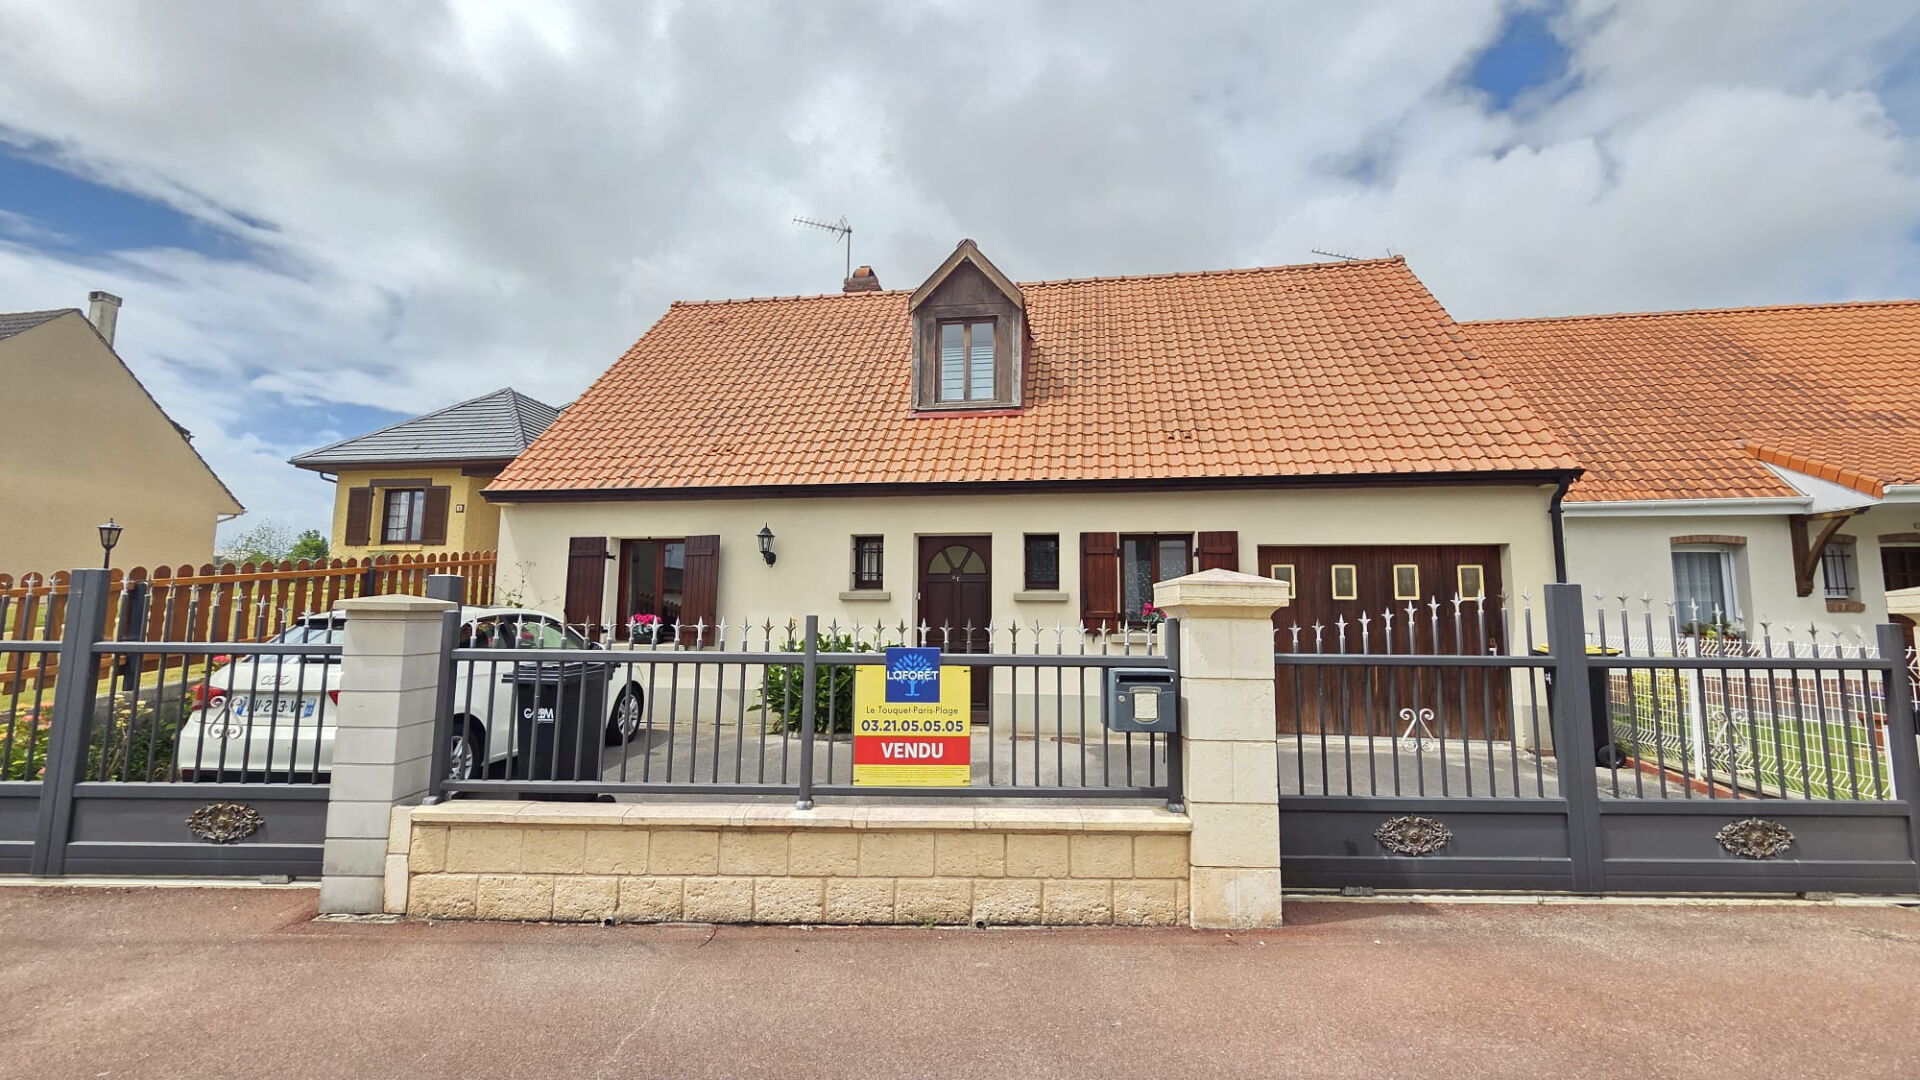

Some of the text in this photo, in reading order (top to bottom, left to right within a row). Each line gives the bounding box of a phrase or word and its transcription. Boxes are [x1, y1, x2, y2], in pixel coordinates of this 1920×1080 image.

[866, 706, 875, 714] Le
[861, 720, 963, 732] 03.21.05.05.05
[881, 742, 943, 758] VENDU
